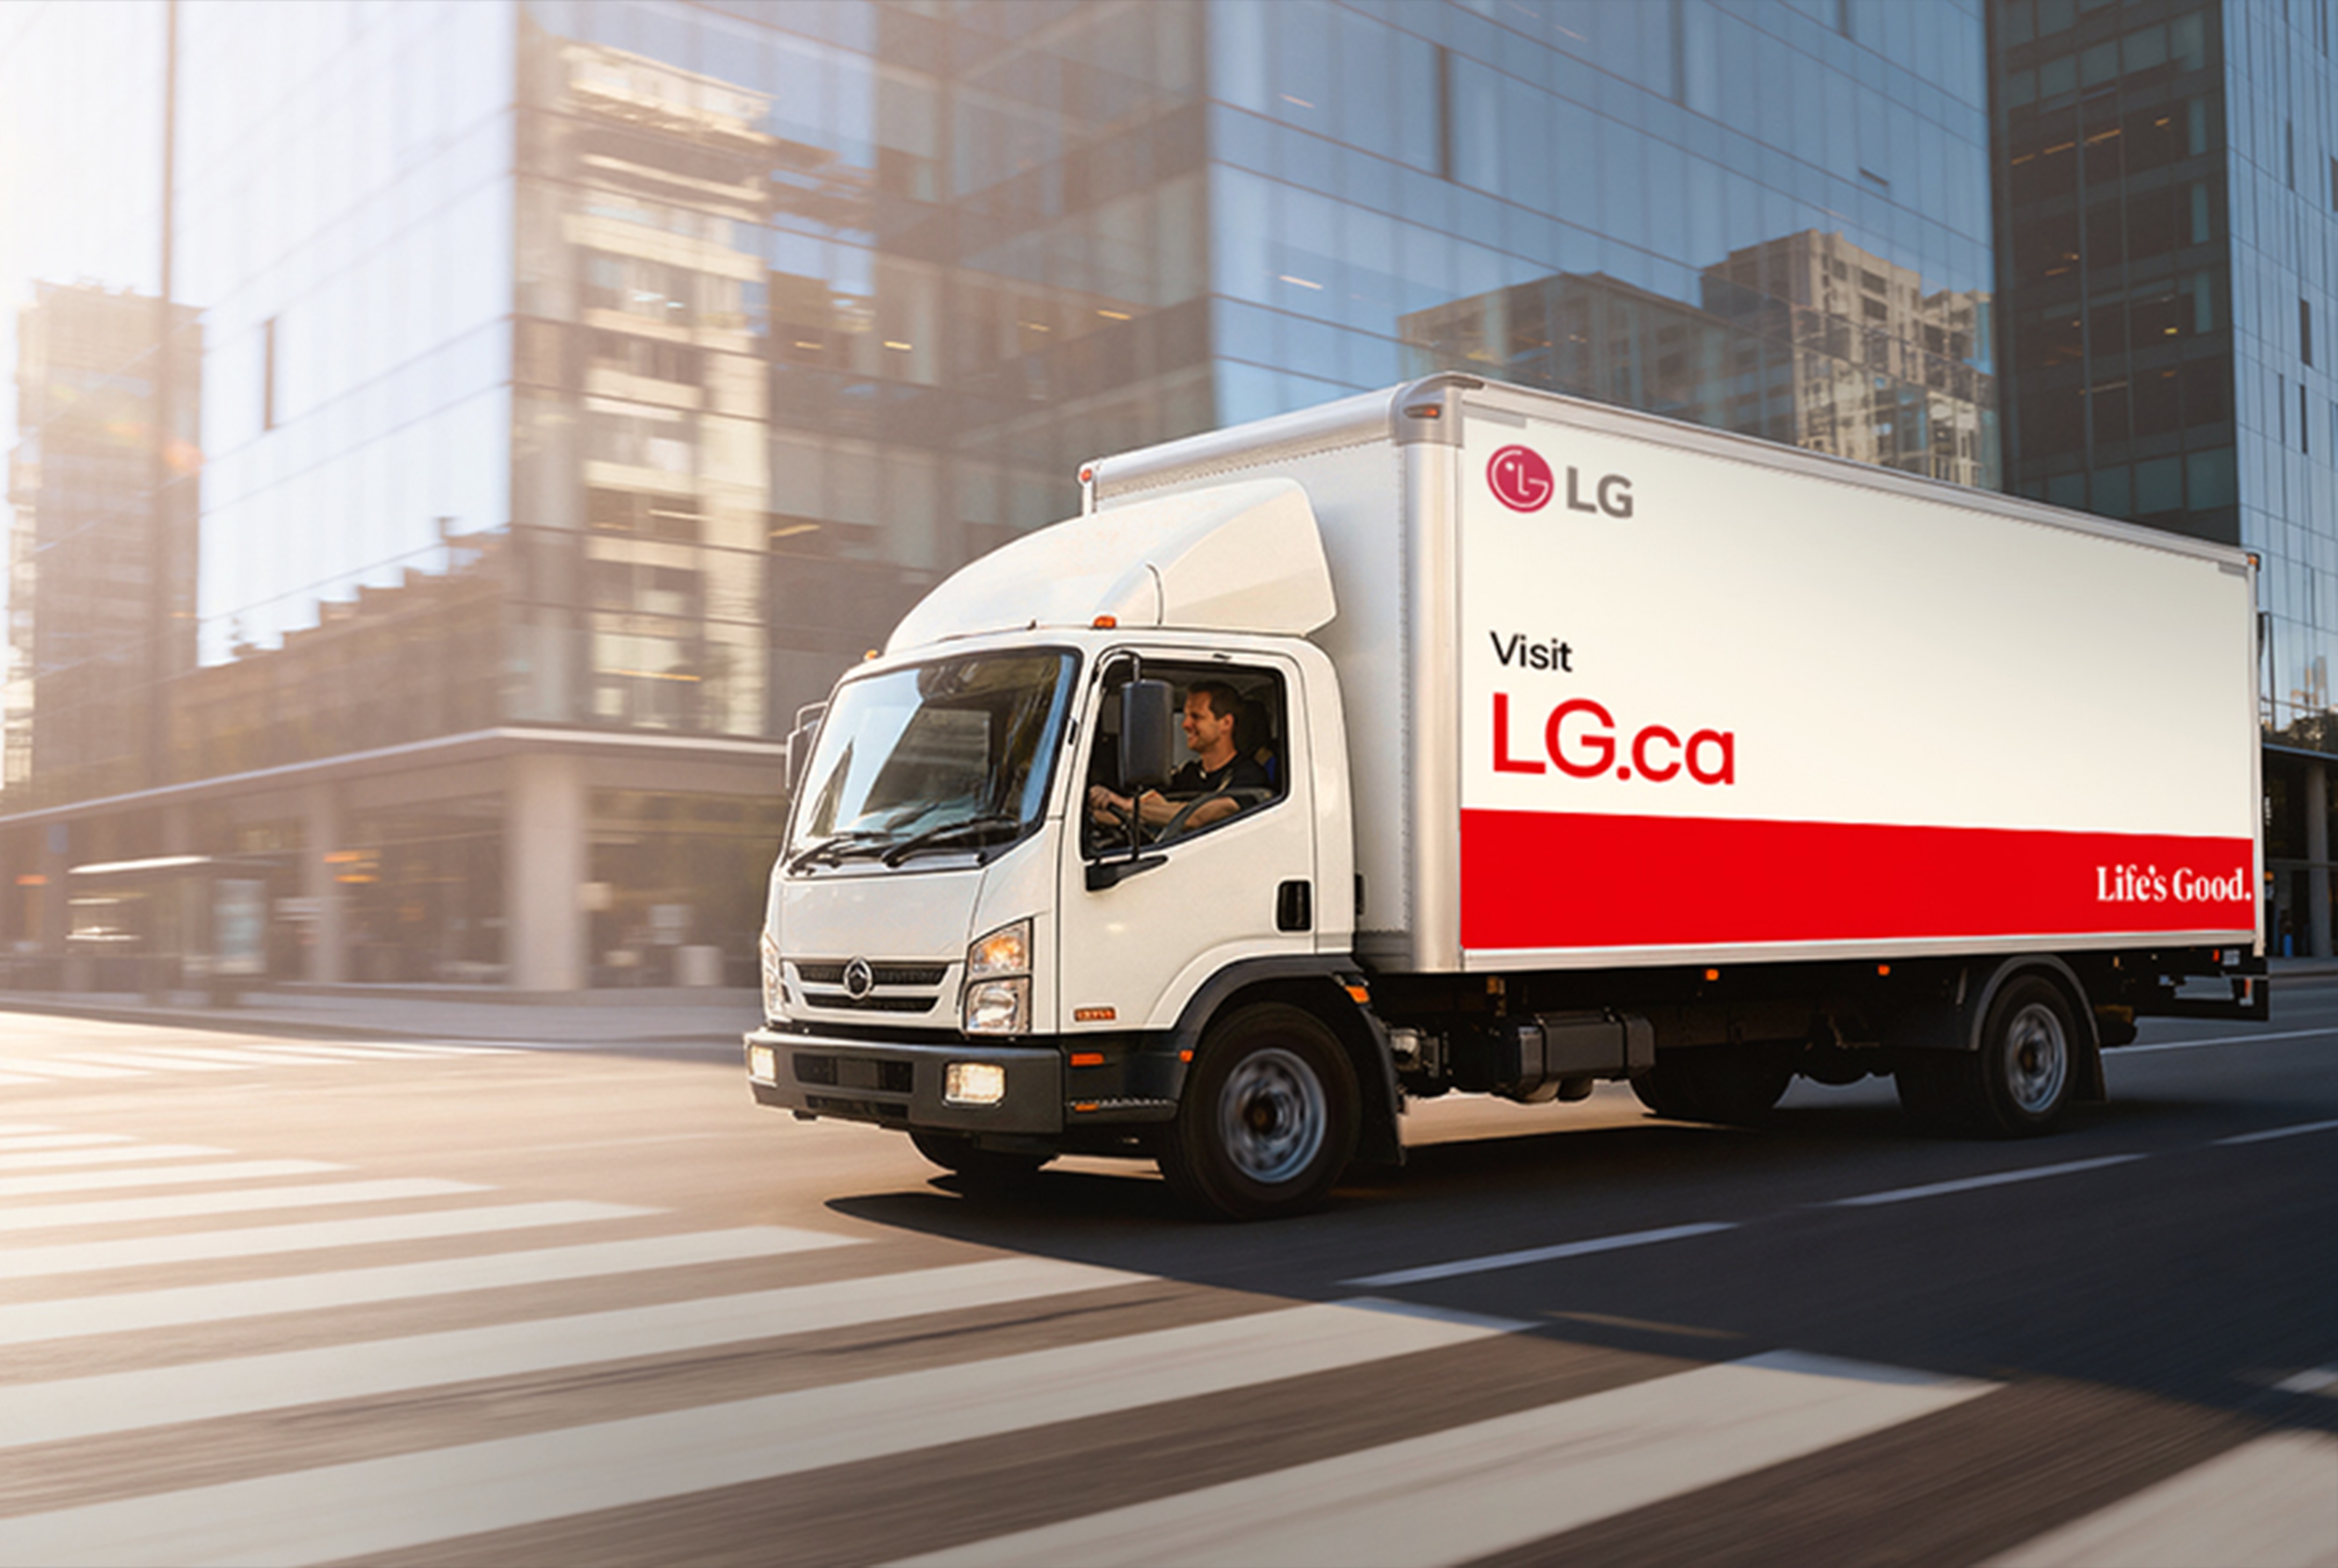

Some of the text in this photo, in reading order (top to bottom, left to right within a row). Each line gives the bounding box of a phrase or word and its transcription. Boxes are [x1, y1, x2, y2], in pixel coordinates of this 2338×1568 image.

[1567, 466, 1633, 518] LG
[1490, 631, 1573, 672] Visit
[1493, 692, 1734, 785] LG.ca
[2097, 864, 2251, 901] Life's Good.
